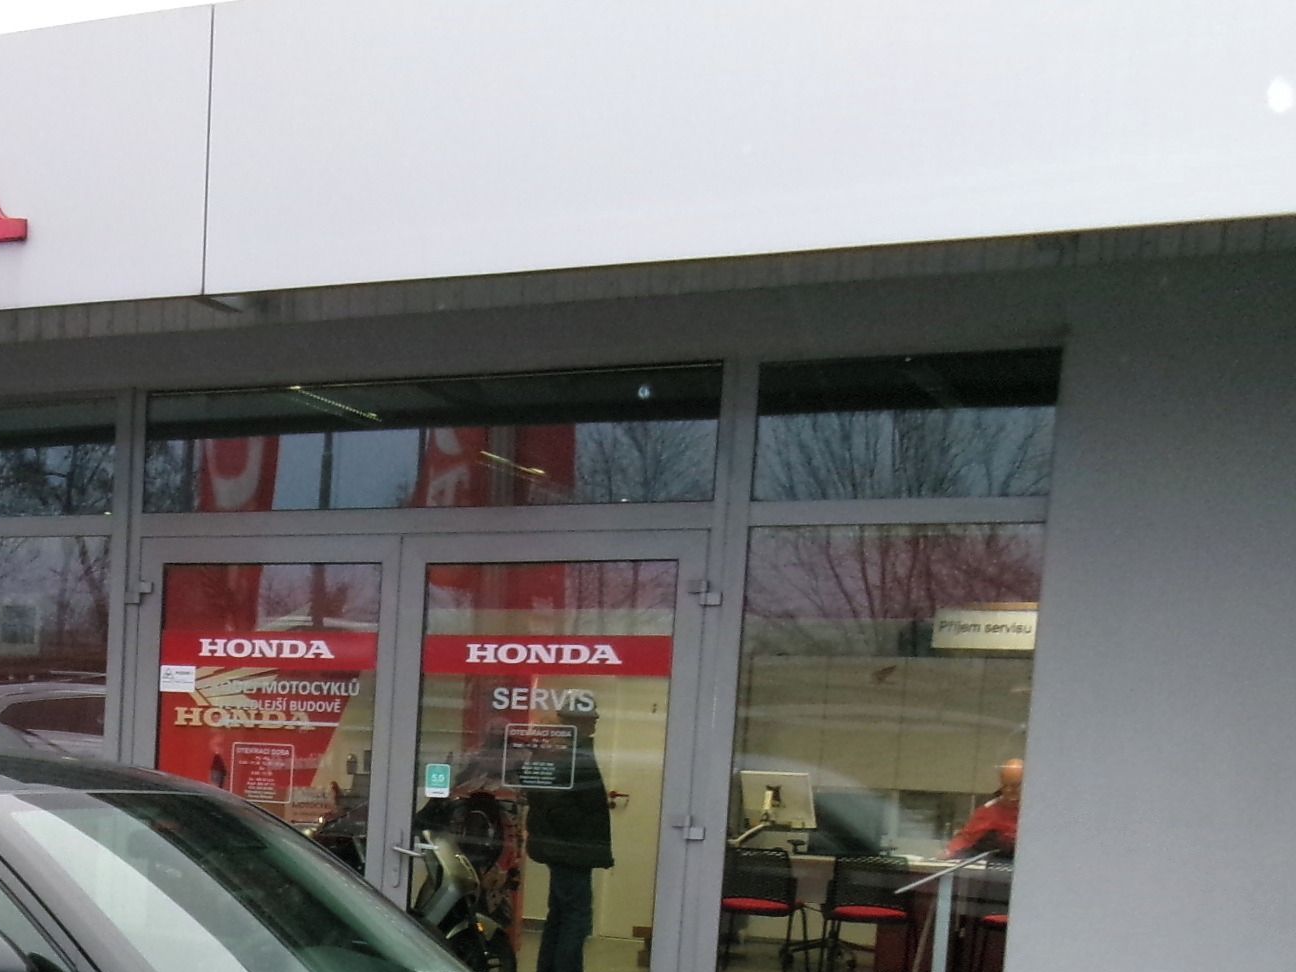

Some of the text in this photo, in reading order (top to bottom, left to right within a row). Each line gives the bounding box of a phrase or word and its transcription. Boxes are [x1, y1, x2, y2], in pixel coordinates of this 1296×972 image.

[198, 638, 335, 659] HONDA
[465, 643, 623, 664] HONDA
[262, 678, 360, 697] MOTOCYKLŮ
[289, 699, 341, 713] BUDOVĚ
[491, 687, 595, 712] SERVIS
[174, 706, 314, 730] HONDA
